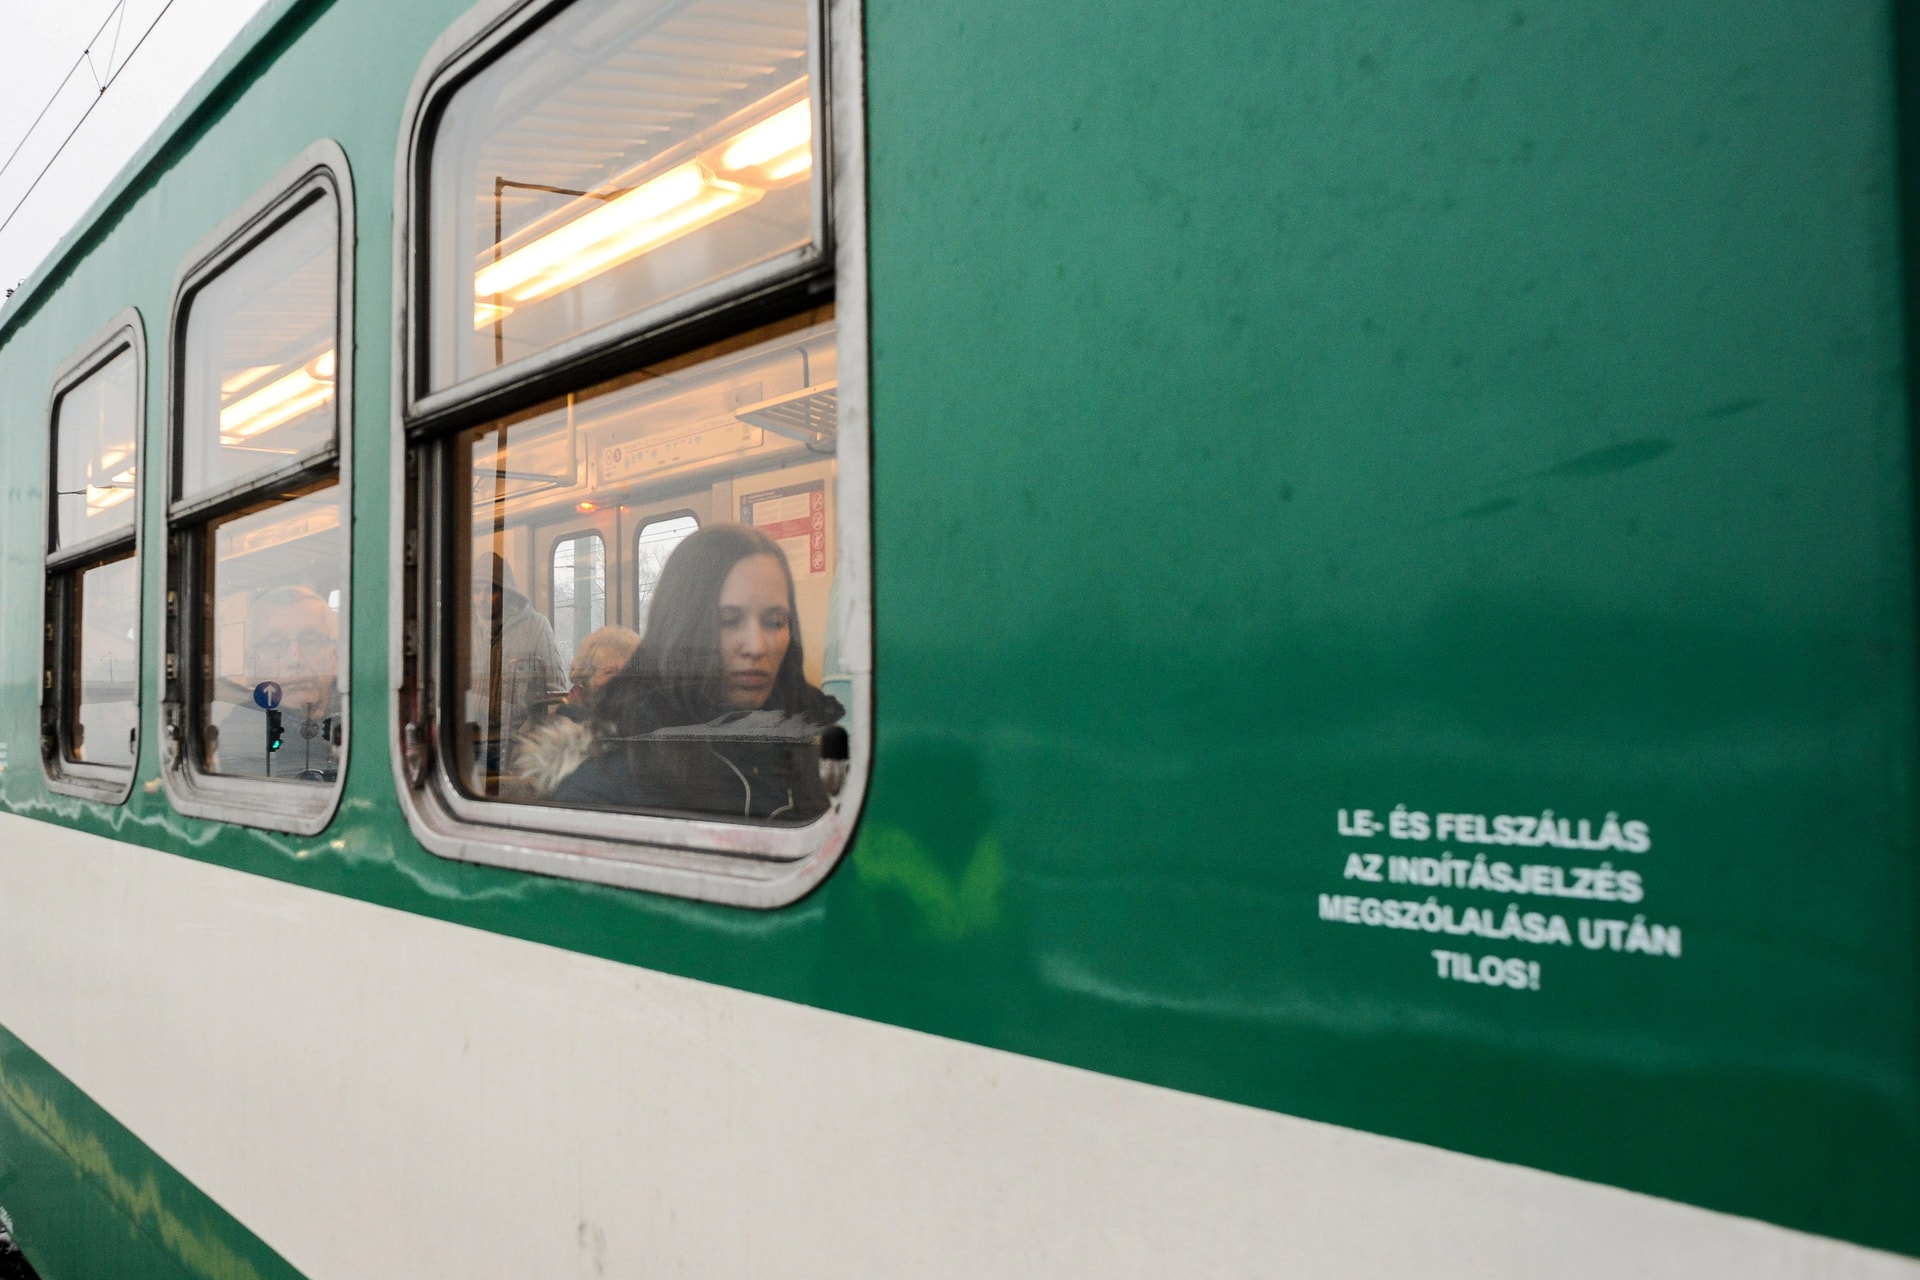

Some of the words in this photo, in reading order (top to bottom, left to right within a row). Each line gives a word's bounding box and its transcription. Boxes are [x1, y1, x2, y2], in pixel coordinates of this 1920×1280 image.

[1338, 809, 1384, 837] LE-
[1389, 803, 1431, 841] ÉS
[1437, 809, 1651, 853] FELSZÁLLÁS
[1343, 852, 1384, 881] AZ
[1388, 851, 1644, 903] INDÍTÁSJELZÉS
[1319, 893, 1573, 946] MEGSZÓLALÁSA
[1578, 914, 1682, 957] UTÁN
[1431, 949, 1541, 990] TILOS!
